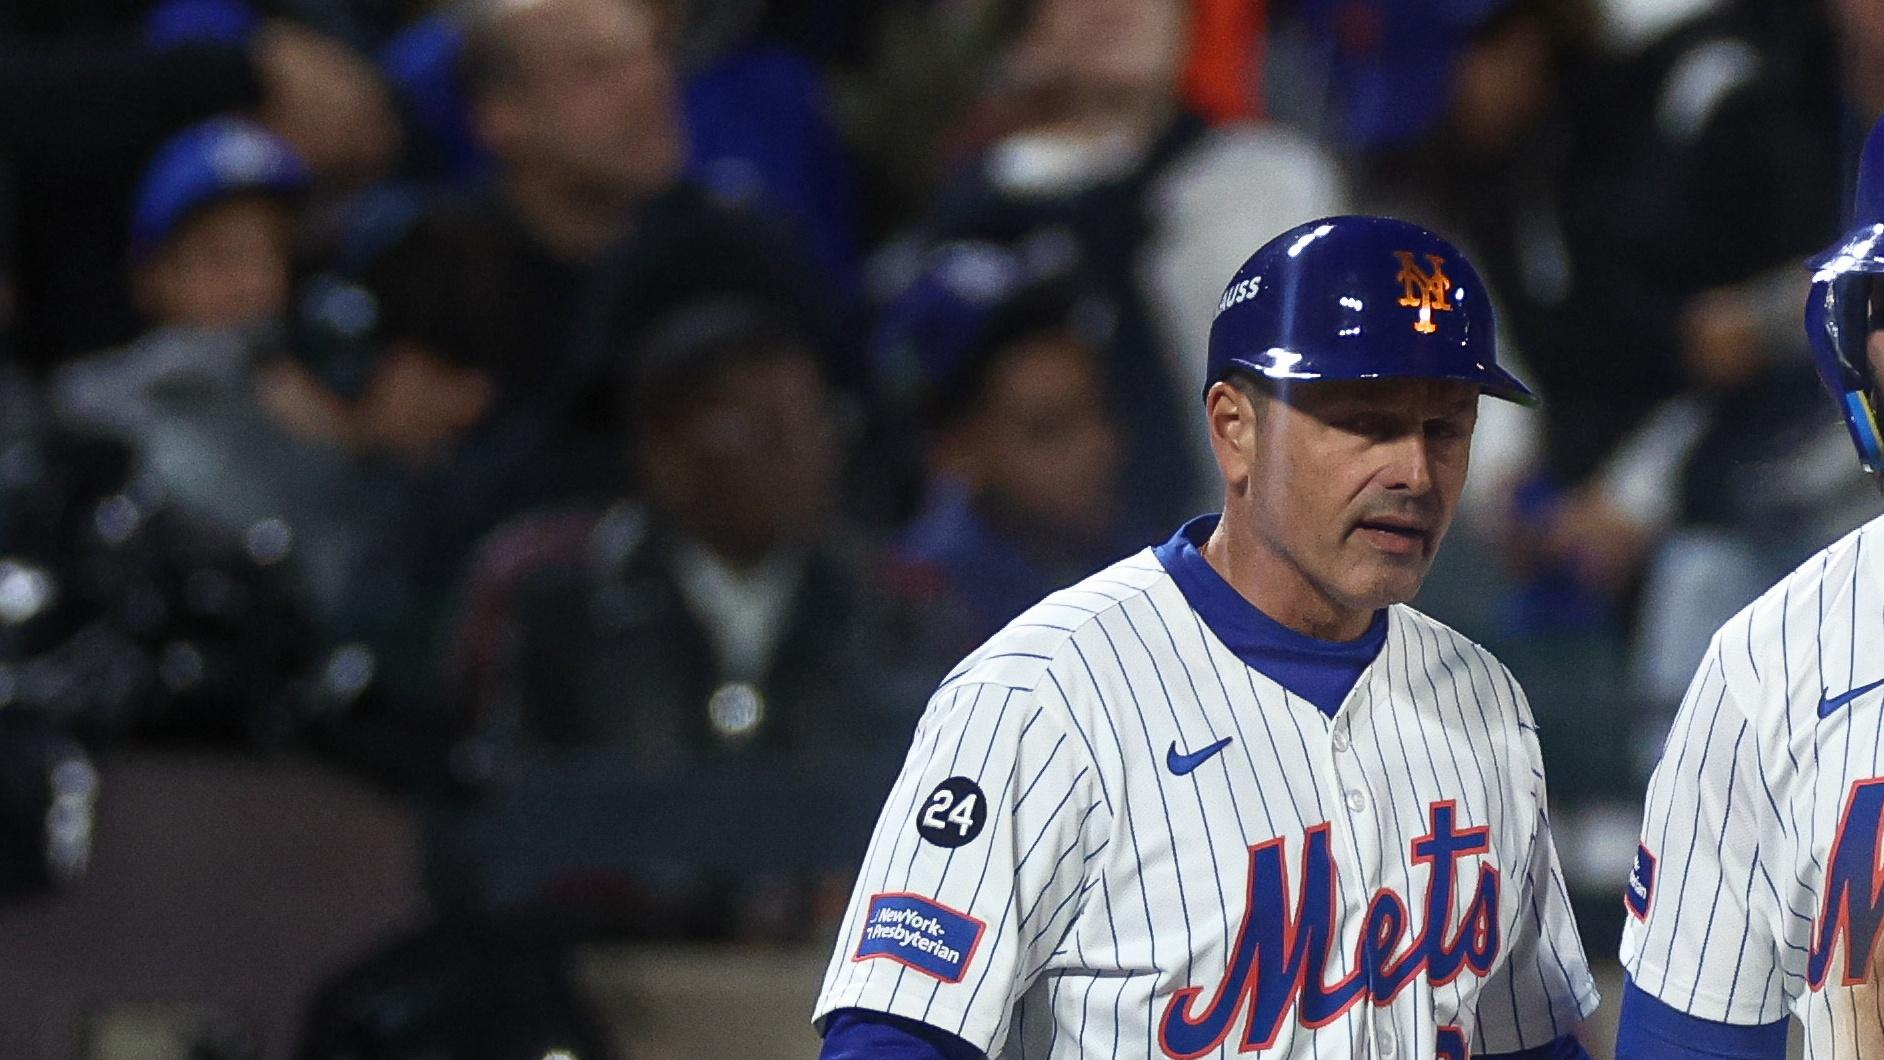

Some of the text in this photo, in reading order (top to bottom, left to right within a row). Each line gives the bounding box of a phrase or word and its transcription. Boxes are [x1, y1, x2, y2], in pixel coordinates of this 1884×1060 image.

[922, 789, 978, 836] 24
[871, 923, 961, 964] Presbyterian
[1158, 799, 1501, 1060] Mets
